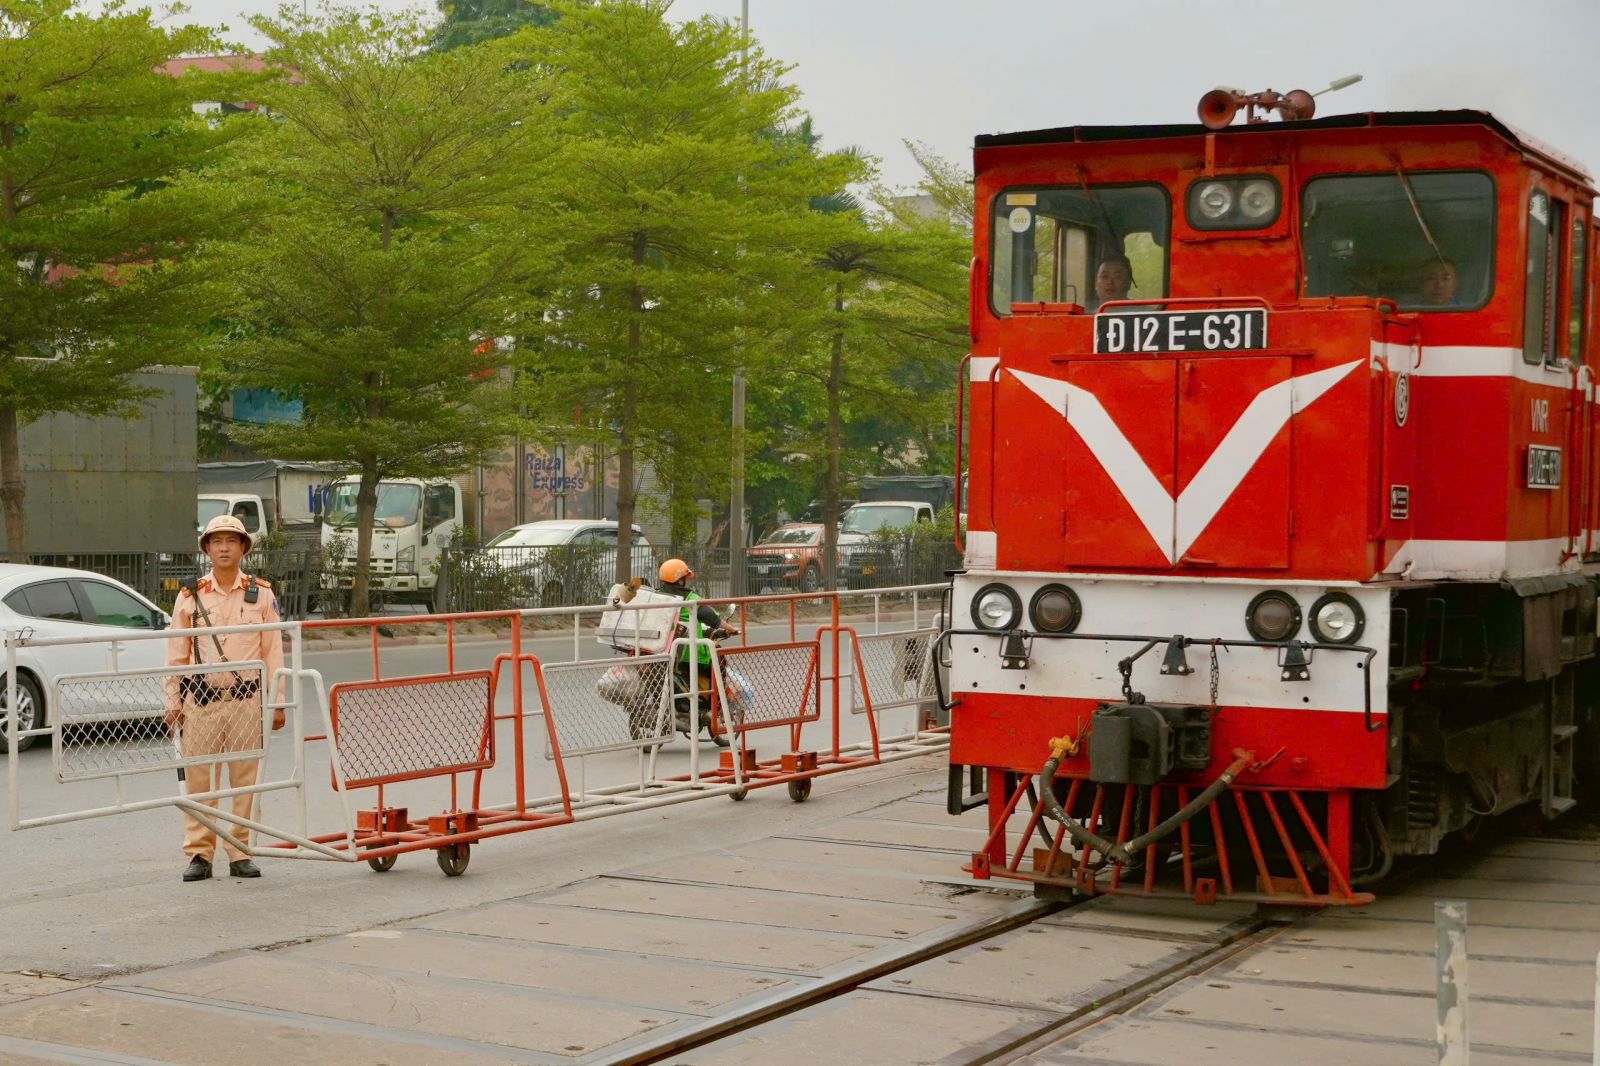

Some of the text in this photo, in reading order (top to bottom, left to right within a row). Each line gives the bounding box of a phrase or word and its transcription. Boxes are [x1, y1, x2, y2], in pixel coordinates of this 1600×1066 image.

[1530, 398, 1549, 432] VNR
[526, 453, 562, 471] Raiza
[533, 472, 584, 492] Express
